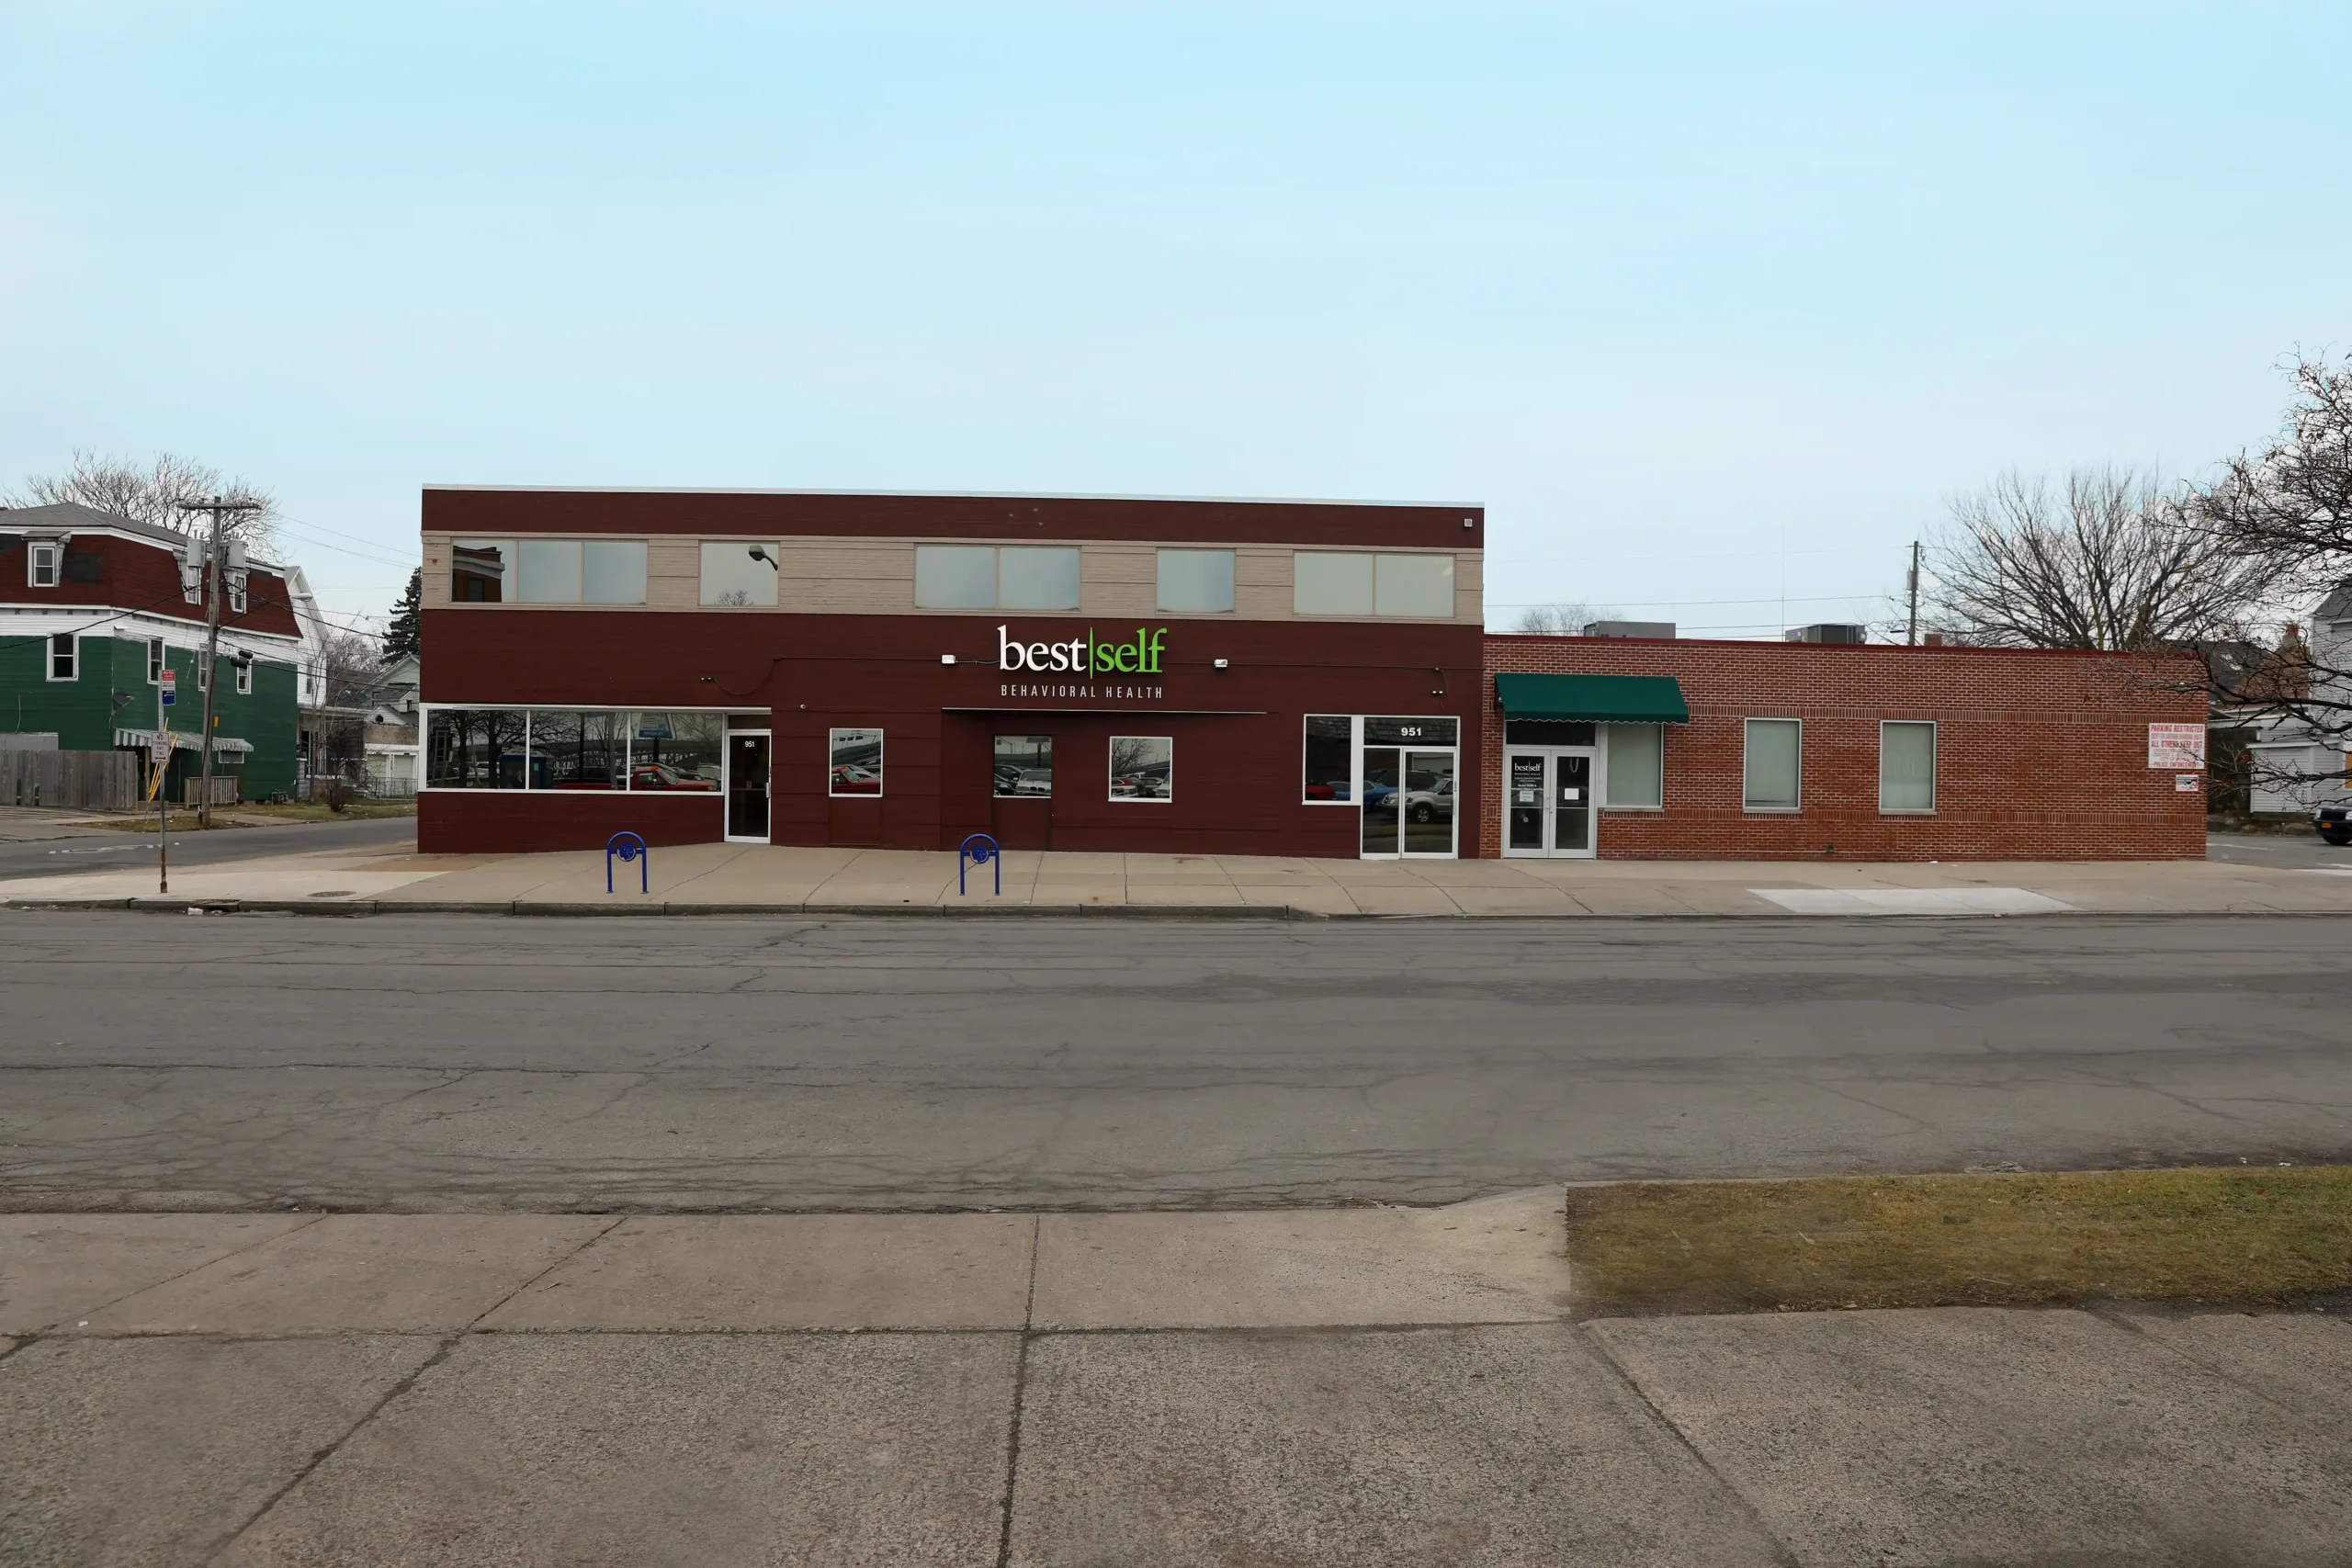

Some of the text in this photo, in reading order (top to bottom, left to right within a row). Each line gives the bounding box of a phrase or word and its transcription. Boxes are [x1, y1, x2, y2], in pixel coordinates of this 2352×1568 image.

[1001, 684, 1162, 698] BEHAVIORAL HEALTH
[1401, 727, 1421, 736] 951
